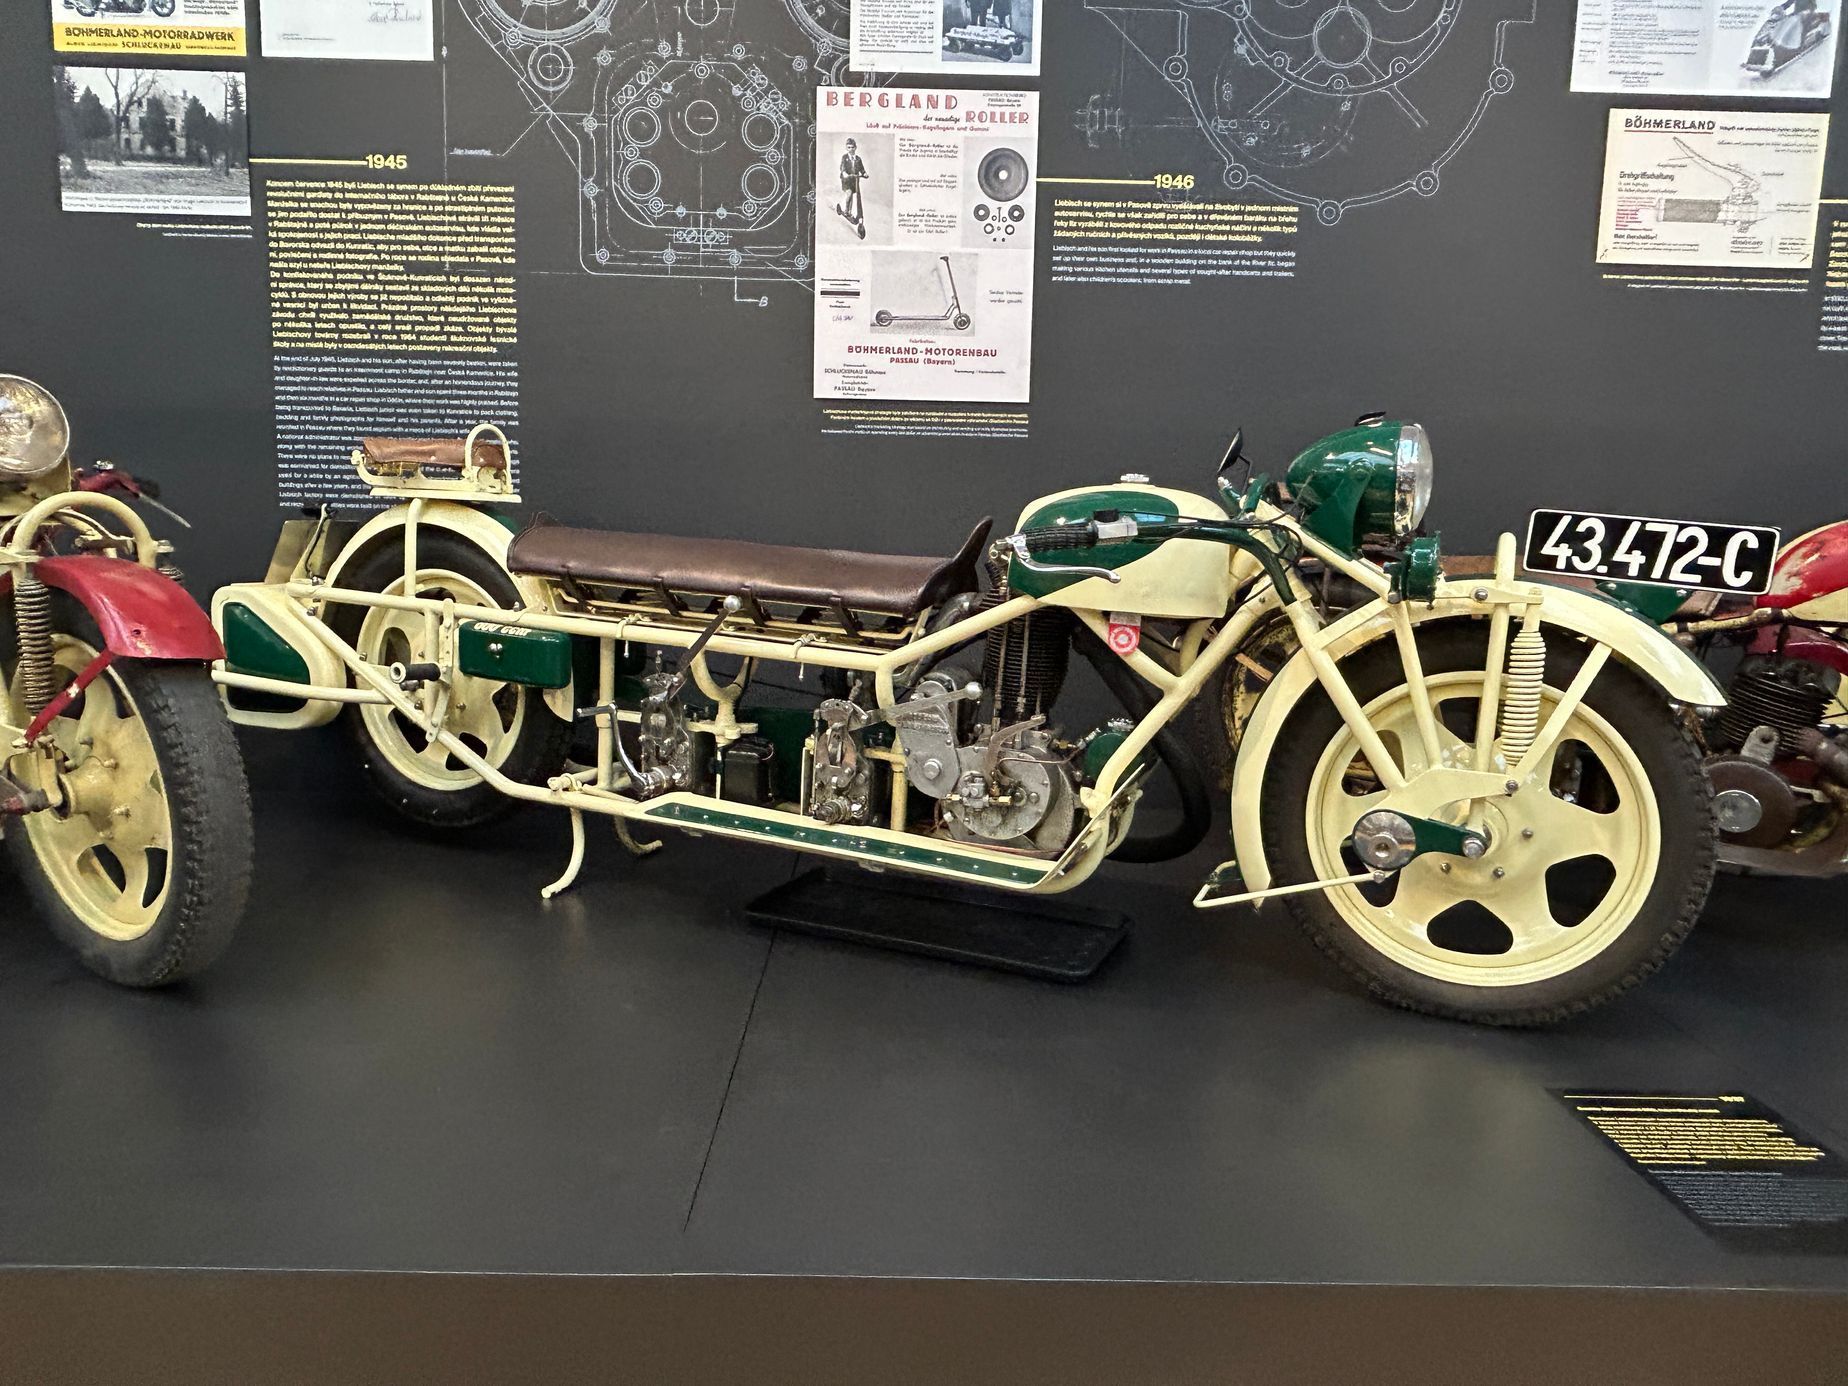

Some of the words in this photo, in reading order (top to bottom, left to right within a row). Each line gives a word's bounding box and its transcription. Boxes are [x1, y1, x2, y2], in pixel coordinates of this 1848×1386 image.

[826, 91, 958, 110] BERGLAND
[965, 110, 1029, 124] ROLLER
[1625, 115, 1716, 130] BÖHMERLAND
[365, 154, 407, 170] 1945
[1154, 174, 1194, 188] 1946
[847, 344, 997, 358] BÖHMERLAND-MOTORENBAU
[923, 358, 956, 366] (Bayern)
[1540, 514, 1759, 588] 43.472-C
